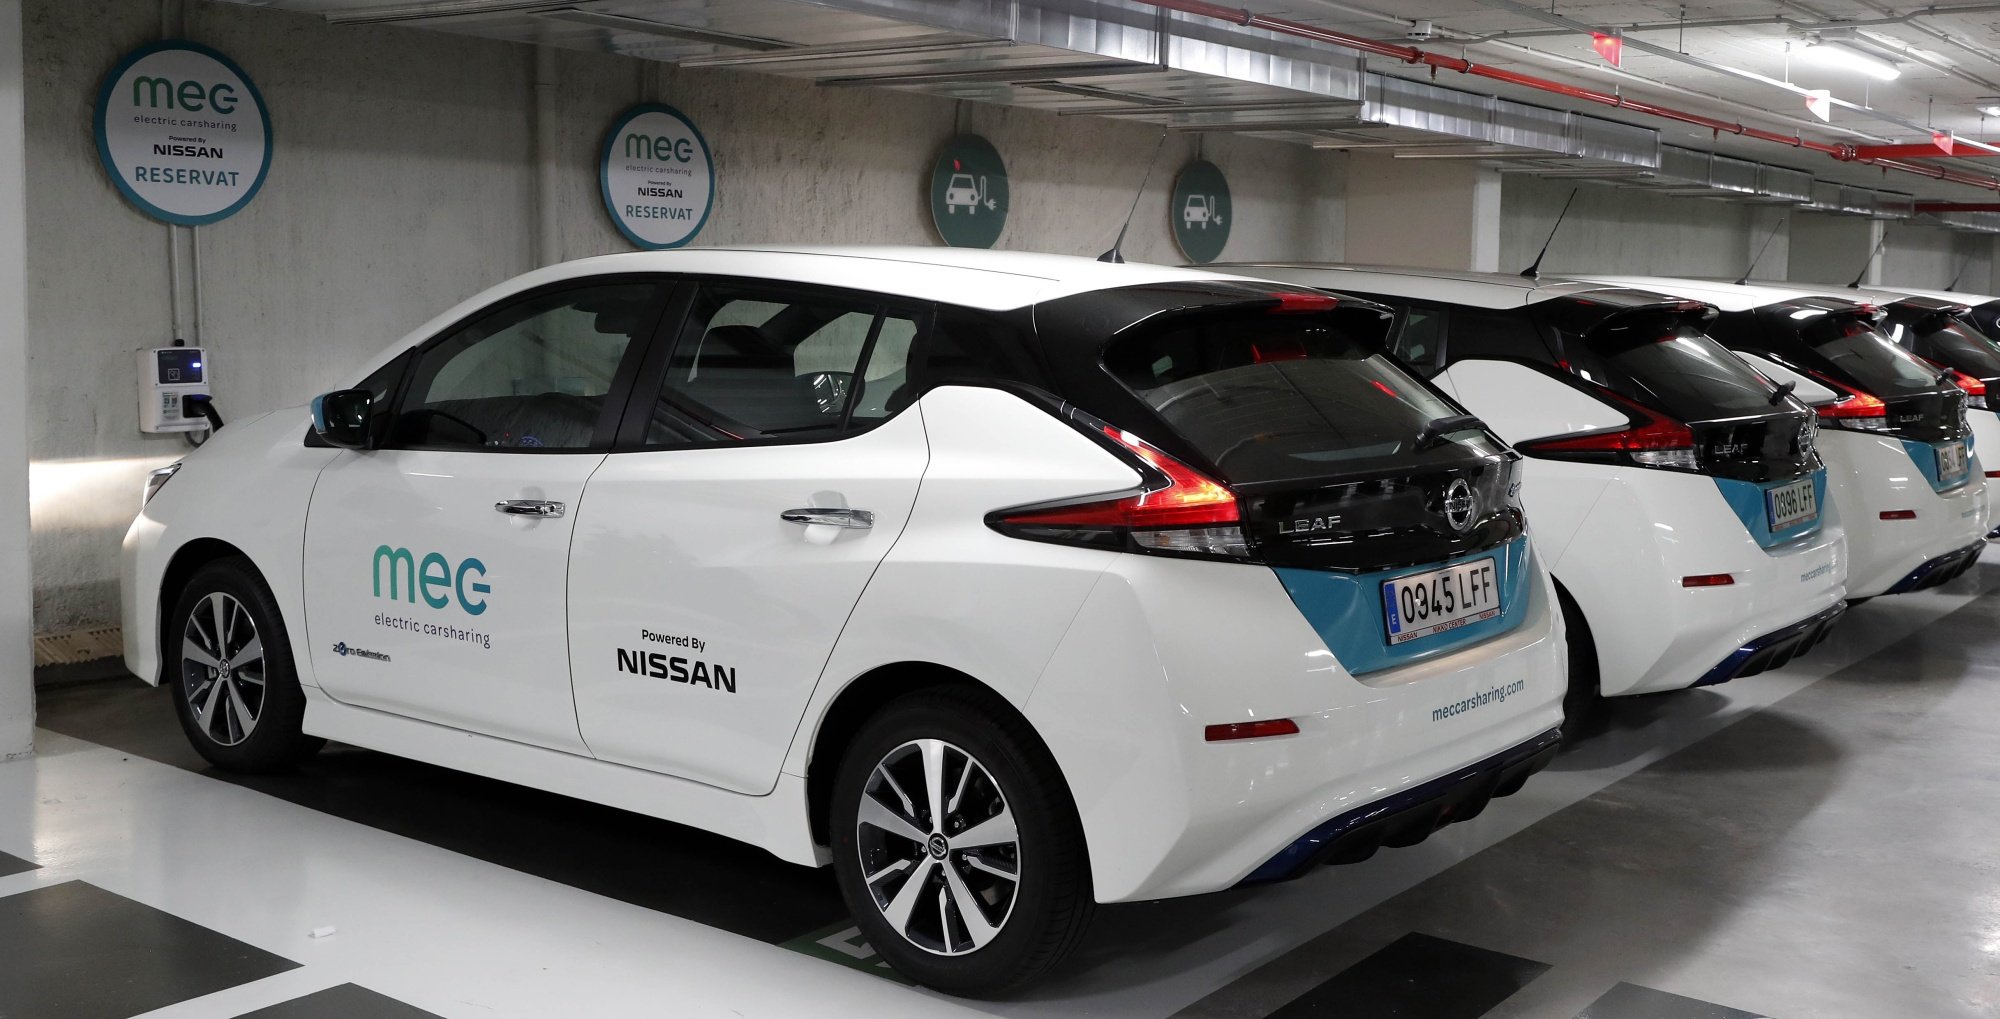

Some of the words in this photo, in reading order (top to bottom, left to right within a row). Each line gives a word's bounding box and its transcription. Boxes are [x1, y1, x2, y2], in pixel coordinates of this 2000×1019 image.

[134, 115, 177, 126] electric
[180, 120, 237, 132] carsharing
[169, 135, 197, 143] Powered
[153, 144, 223, 159] NISSAN
[135, 166, 239, 187] RESERVAT
[626, 164, 653, 173] electric
[655, 167, 692, 177] carsharing
[637, 187, 683, 198] NISSAN
[626, 204, 693, 220] RESERVAT
[1900, 413, 1924, 422] LEAF
[1714, 443, 1749, 455] LEAF
[1798, 484, 1813, 512] LFF
[1278, 515, 1341, 534] LEAF
[1402, 576, 1455, 624] 0945
[1458, 566, 1490, 609] LFF
[374, 612, 420, 633] electric
[423, 625, 491, 650] carsharing
[1397, 632, 1418, 642] NISSAN
[1448, 618, 1467, 629] CENTER
[1479, 610, 1496, 620] NISSAN
[642, 629, 689, 648] Powered
[691, 637, 706, 653] By
[617, 647, 736, 694] NISSAN
[1432, 679, 1524, 722] meccarsharing.com
